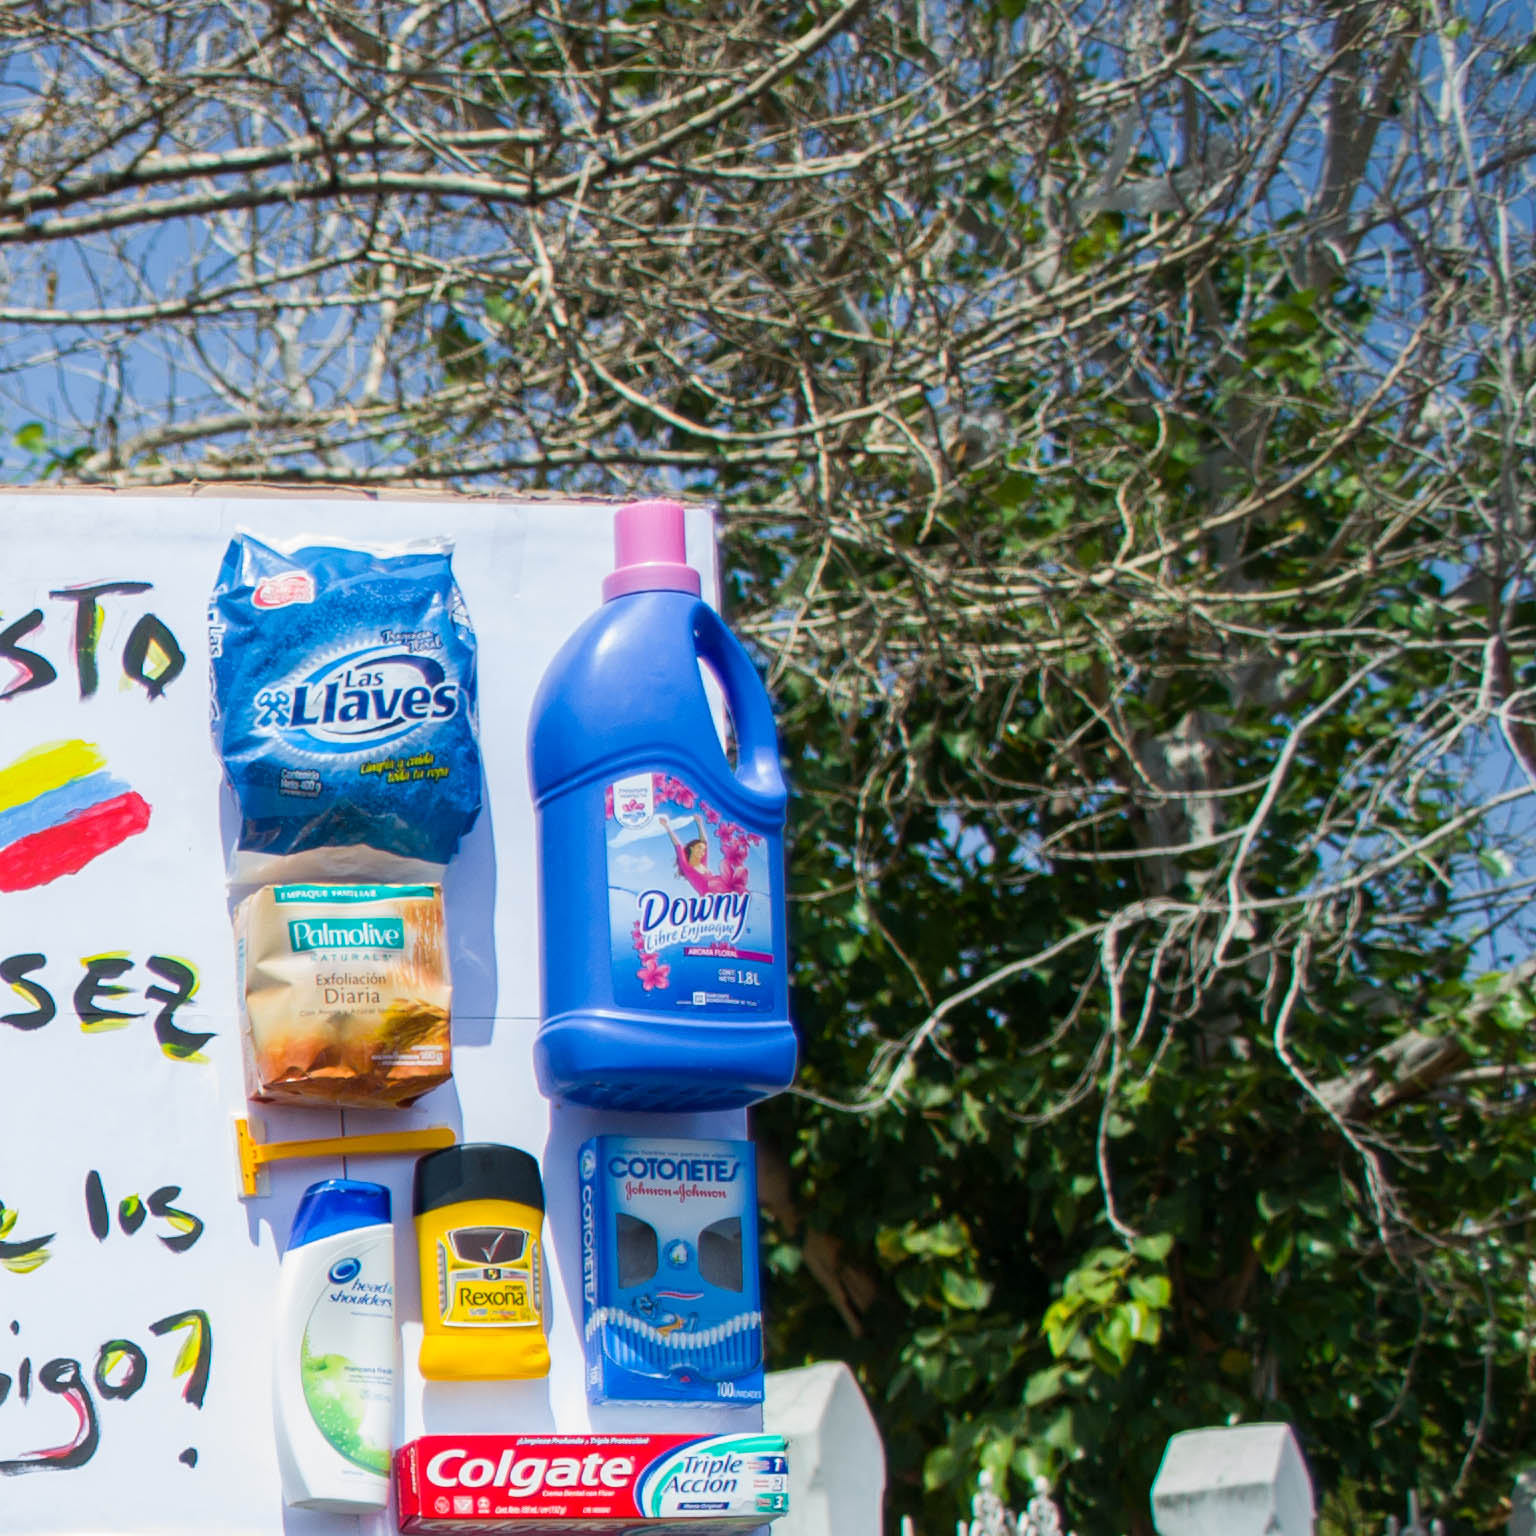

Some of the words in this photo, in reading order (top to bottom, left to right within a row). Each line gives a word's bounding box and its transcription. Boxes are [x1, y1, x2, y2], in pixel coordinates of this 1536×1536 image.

[344, 669, 384, 689] Las
[290, 676, 457, 727] Llaves
[638, 890, 750, 941] Downy
[292, 921, 400, 950] Palmolive
[315, 972, 387, 986] Exfoliación
[324, 987, 381, 1005] Diaria
[608, 1156, 741, 1183] COTONETES
[85, 1169, 205, 1254] los
[460, 1287, 524, 1307] Rexona
[716, 1382, 734, 1398] 100
[426, 1448, 633, 1498] Colgate
[684, 1454, 743, 1477] Triple
[663, 1474, 737, 1493] Acción
